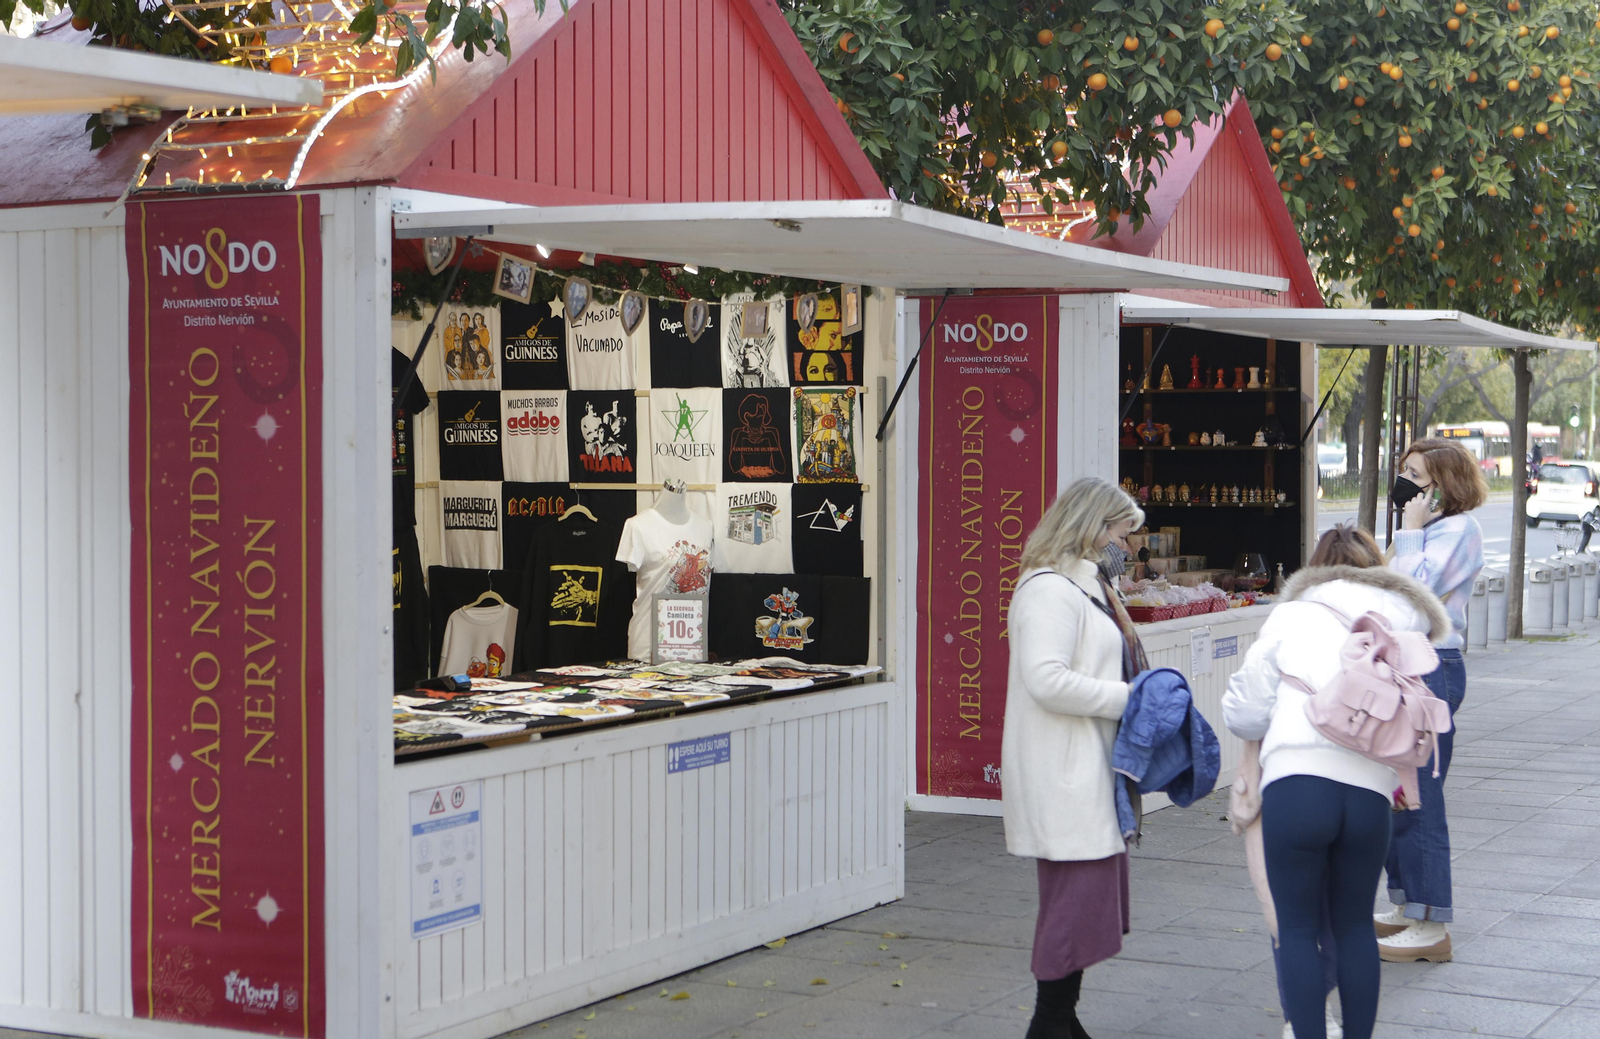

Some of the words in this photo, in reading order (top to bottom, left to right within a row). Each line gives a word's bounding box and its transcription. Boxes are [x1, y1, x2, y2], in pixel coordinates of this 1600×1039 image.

[230, 297, 243, 307] DE
[184, 315, 216, 327] Distrito
[218, 313, 255, 325] Nervión
[660, 318, 683, 333] Pepe
[505, 344, 558, 360] GUINNESS
[984, 366, 1011, 374] Nervión
[507, 399, 534, 409] MUCHOS
[479, 422, 490, 430] DE
[507, 411, 560, 430] adobo
[444, 428, 499, 443] GUINNESS
[579, 444, 634, 473] TRIANA
[654, 442, 716, 462] JOAQUEEN
[957, 386, 984, 564] NAVIDEÑO
[182, 347, 220, 638] NAVIDEÑO
[728, 490, 778, 508] TREMENDO
[443, 497, 498, 510] MARGUERITA
[444, 511, 498, 528] MARGUERÓ
[236, 514, 276, 769] NERVIÓN
[958, 570, 983, 742] MERCADO
[680, 744, 696, 757] ESPERE
[190, 650, 222, 933] MERCADO
